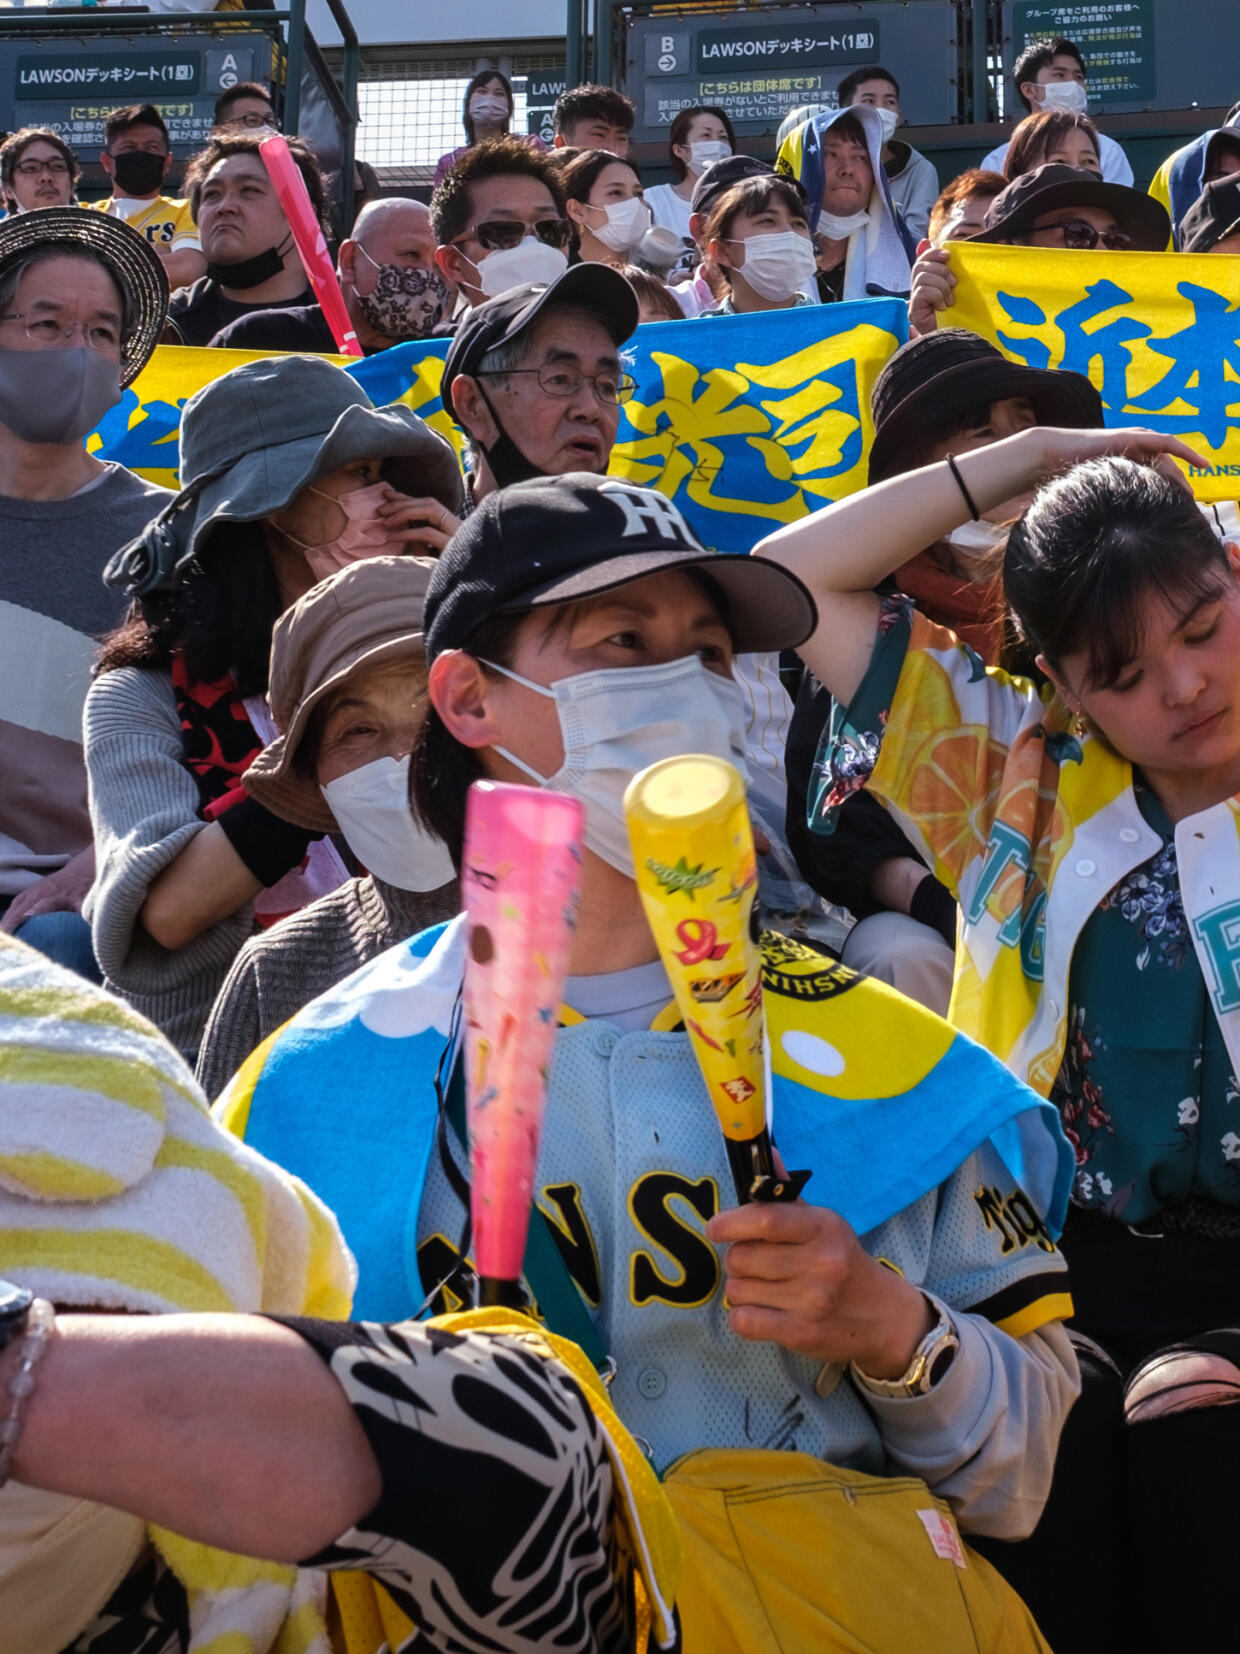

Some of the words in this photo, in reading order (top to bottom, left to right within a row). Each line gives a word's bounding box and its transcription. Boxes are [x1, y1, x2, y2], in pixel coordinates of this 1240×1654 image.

[661, 36, 674, 52] B
[221, 54, 237, 70] A
[541, 113, 553, 126] A
